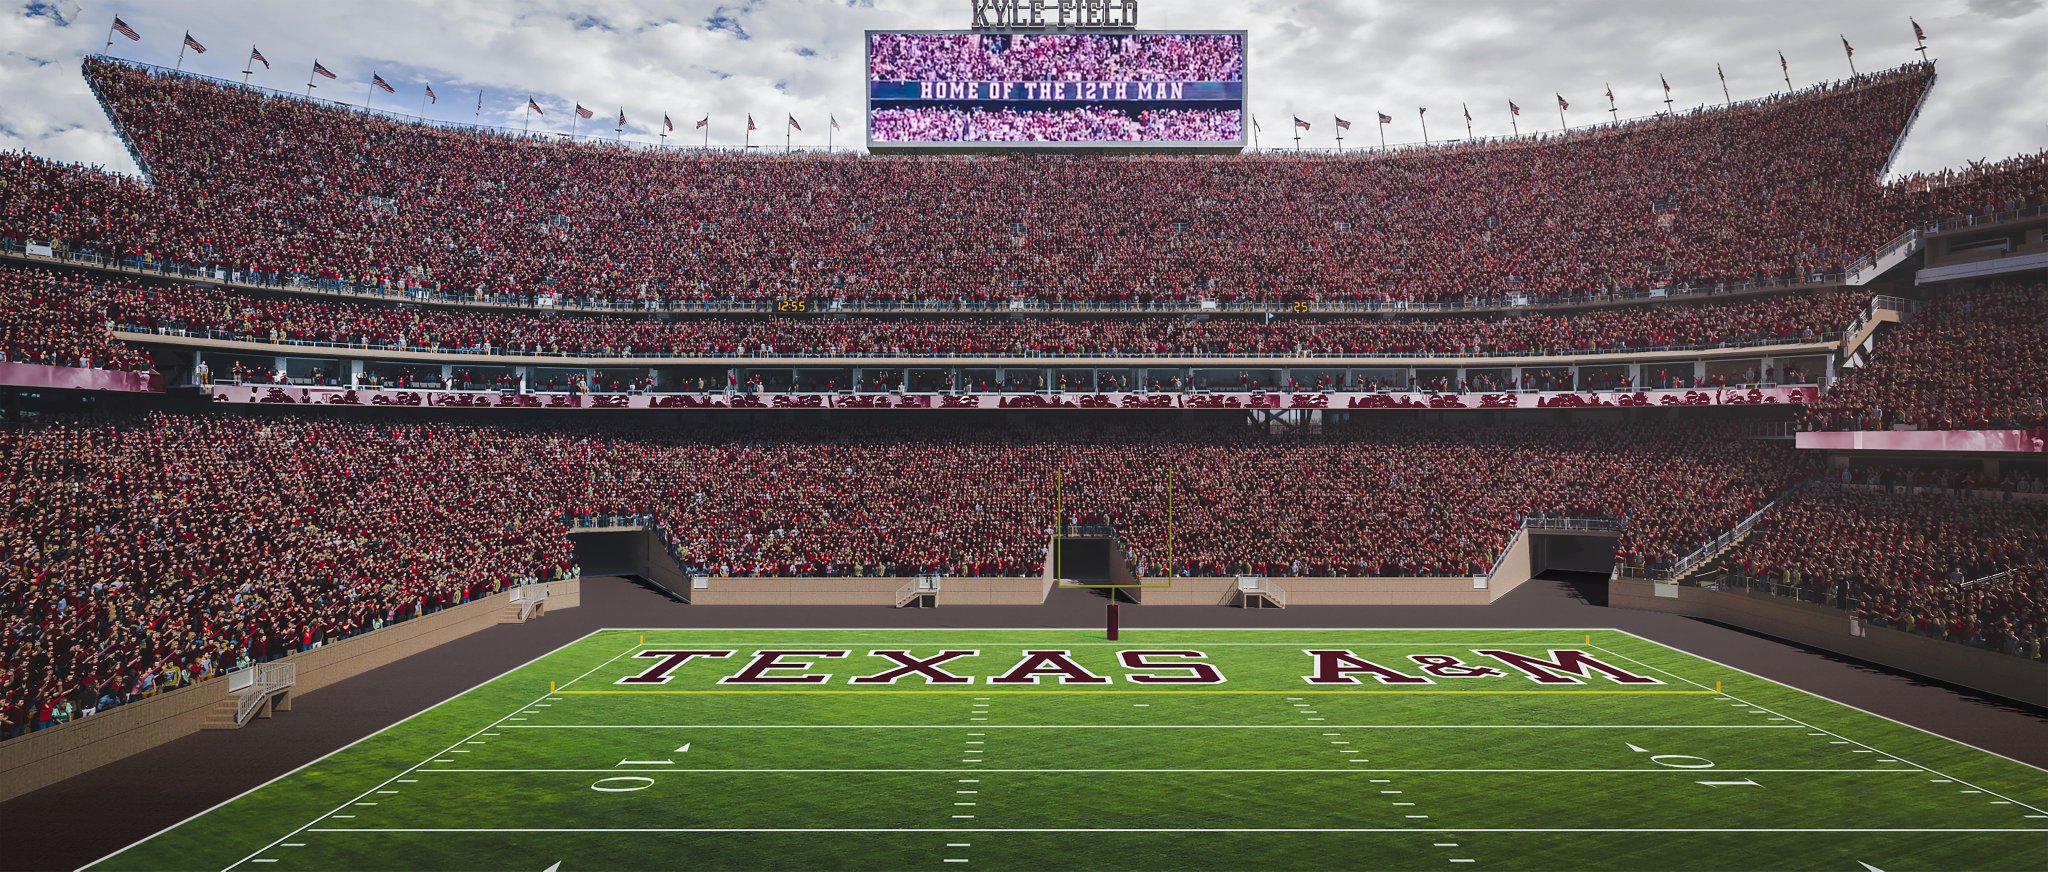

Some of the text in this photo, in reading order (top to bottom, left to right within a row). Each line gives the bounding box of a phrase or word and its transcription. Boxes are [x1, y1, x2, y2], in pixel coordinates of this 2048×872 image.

[971, 0, 1138, 28] KYLE FIELD
[920, 81, 1184, 99] HOME OF THE 12TH MAN
[777, 301, 806, 312] 12:55
[1293, 301, 1309, 312] 25
[613, 649, 1667, 686] TEXAS A&M
[590, 757, 676, 793] 10
[1649, 754, 1767, 789] 10
